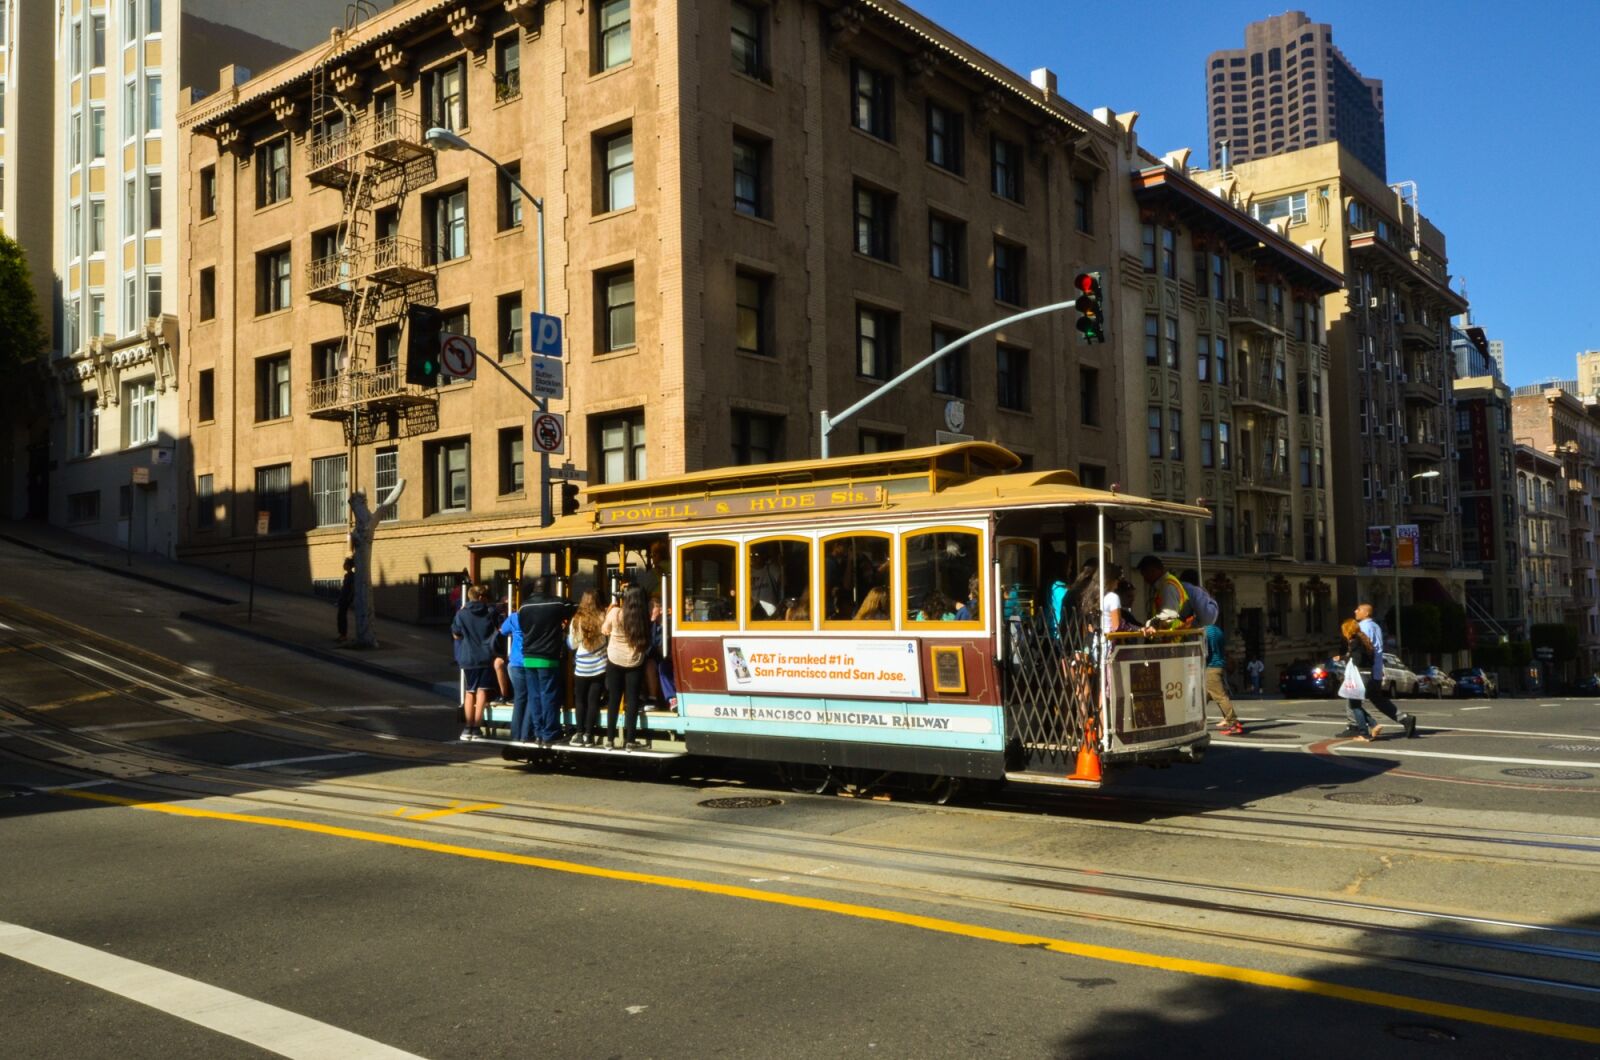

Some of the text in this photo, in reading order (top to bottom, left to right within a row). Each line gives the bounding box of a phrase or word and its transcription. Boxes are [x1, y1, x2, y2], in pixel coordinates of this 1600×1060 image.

[536, 377, 561, 387] Stockton
[536, 385, 557, 394] Garage
[611, 506, 697, 522] POWELL
[716, 502, 730, 514] &
[750, 493, 816, 511] HYDE
[691, 657, 718, 673] 23
[749, 653, 854, 666] AT&T is ranked #1 in
[754, 666, 906, 682] San Francisco and San Jose.
[1165, 681, 1183, 700] 23
[714, 706, 950, 730] SAN FRANCISCO MUNICIPAL RAILWAY
